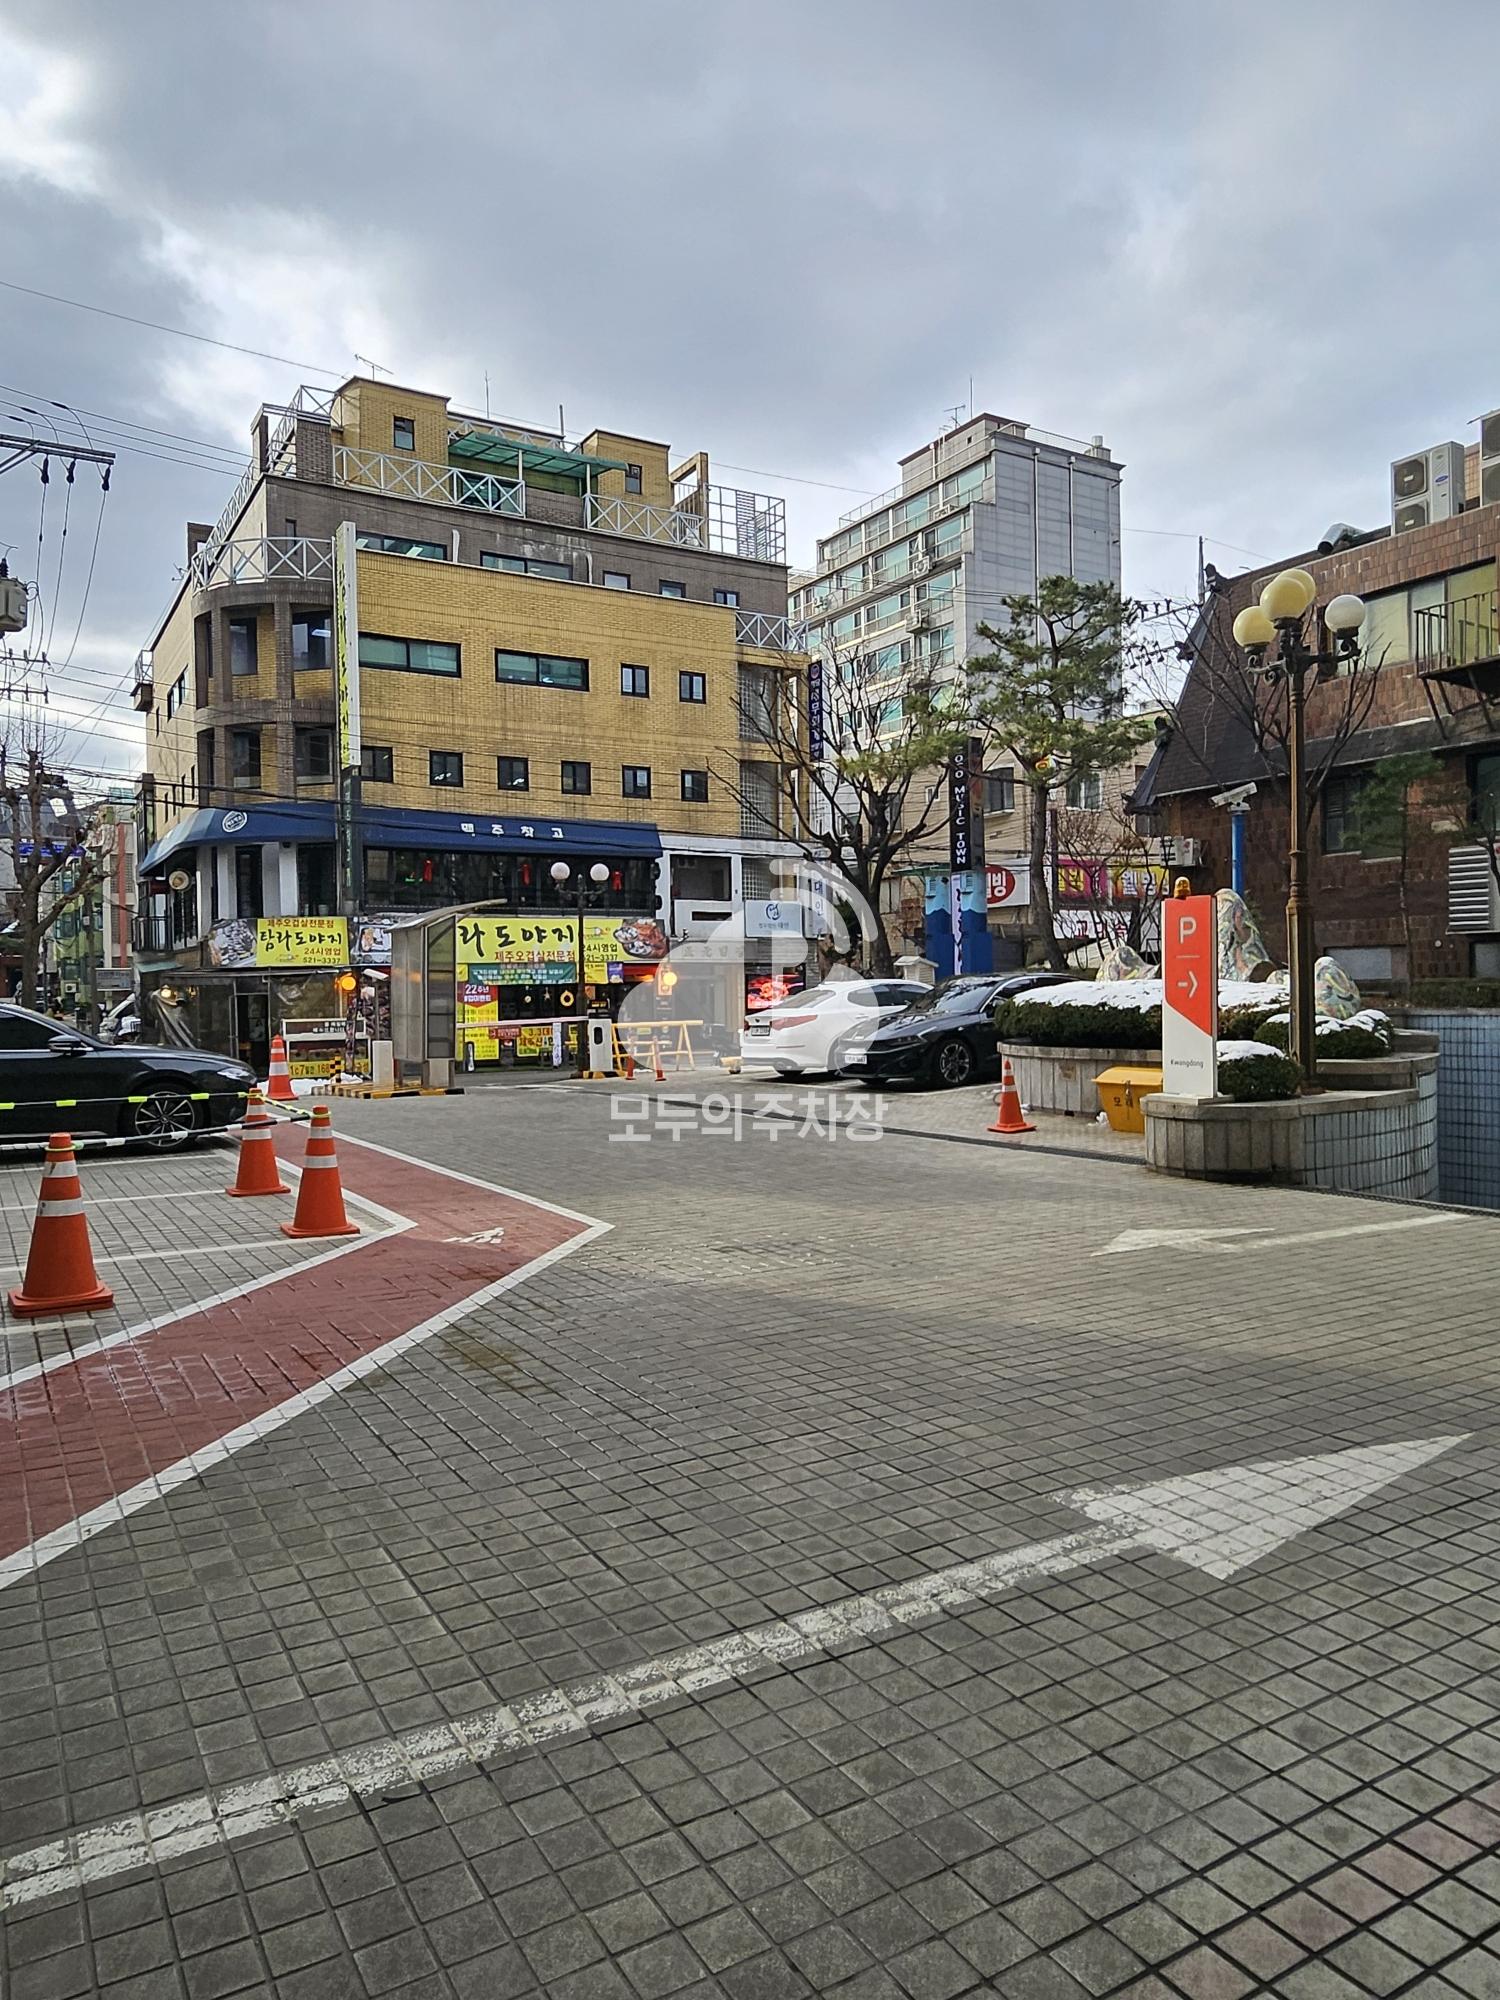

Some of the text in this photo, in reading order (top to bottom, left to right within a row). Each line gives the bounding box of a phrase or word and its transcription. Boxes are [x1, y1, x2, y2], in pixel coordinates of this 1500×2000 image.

[461, 823, 564, 839] 맥주창고
[955, 833, 967, 865] TOWN
[267, 918, 334, 929] 제주오겹살전문점
[1179, 916, 1197, 944] P
[260, 929, 342, 952] 탐라도야지
[304, 947, 341, 956] 24시영업
[494, 951, 576, 962] 제주오겹살전문점
[1170, 1060, 1204, 1068] Kwangdong
